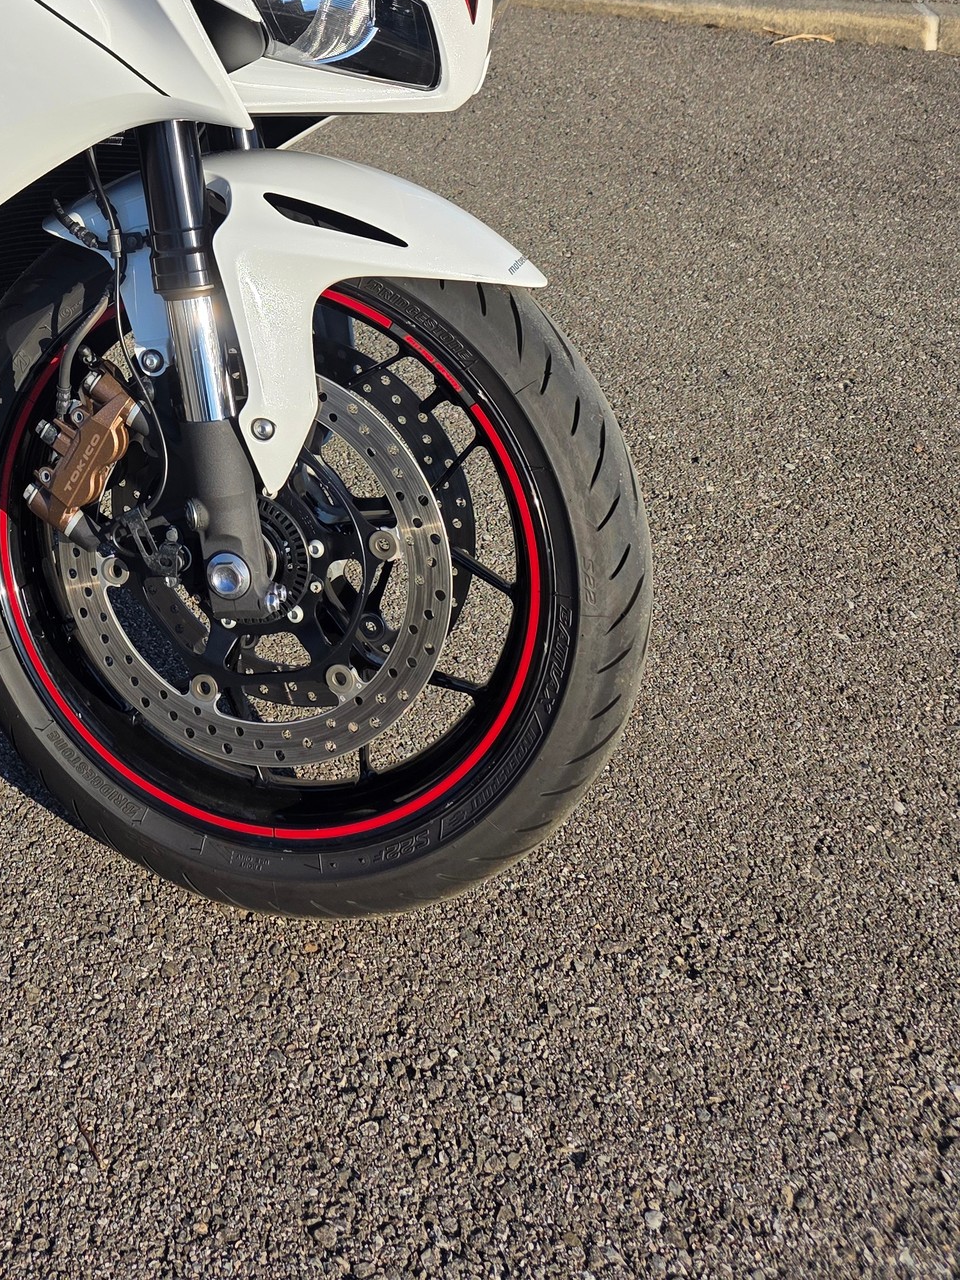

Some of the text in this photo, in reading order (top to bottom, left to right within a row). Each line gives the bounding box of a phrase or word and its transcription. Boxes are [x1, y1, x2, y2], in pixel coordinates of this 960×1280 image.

[366, 279, 474, 361] BRIDGESTONE
[64, 434, 100, 492] TOKICO
[539, 604, 573, 714] BATTLAX
[46, 729, 142, 818] BRIDGESTONE
[471, 727, 536, 811] HYPERSPORT
[373, 830, 430, 864] S22F
